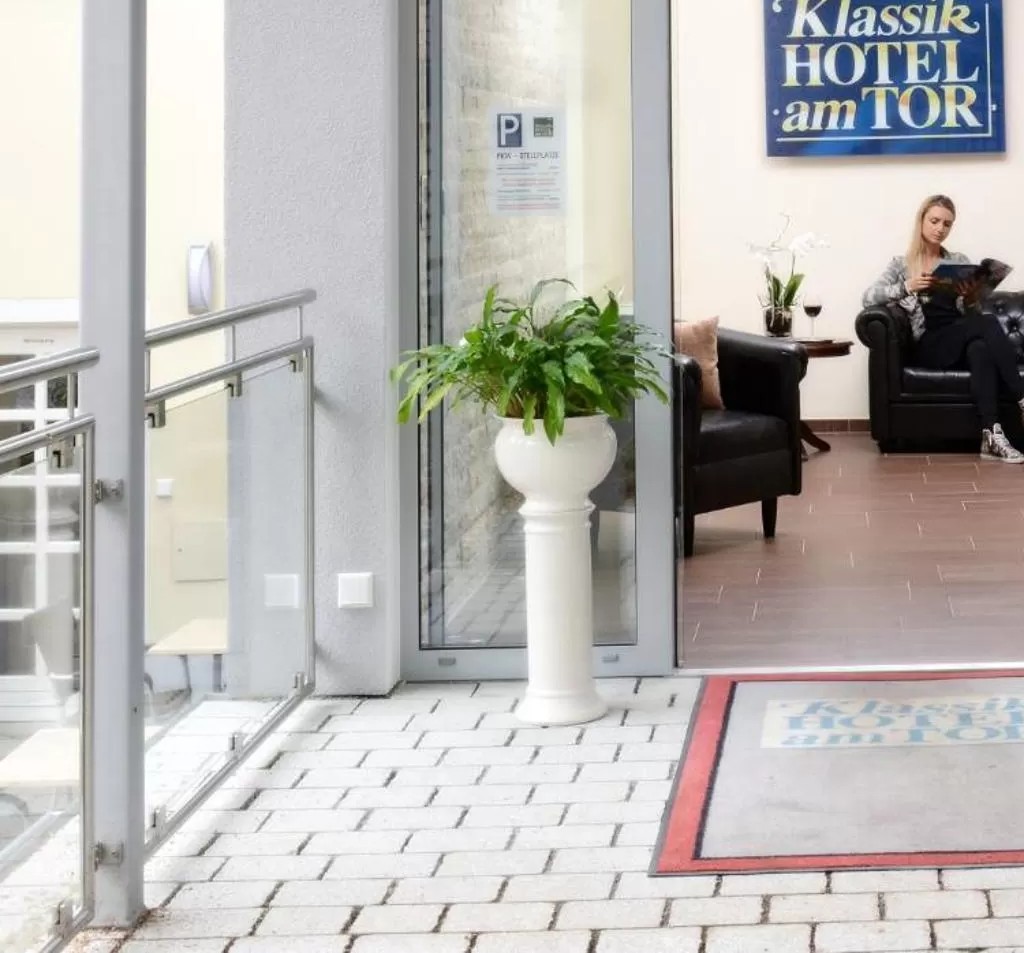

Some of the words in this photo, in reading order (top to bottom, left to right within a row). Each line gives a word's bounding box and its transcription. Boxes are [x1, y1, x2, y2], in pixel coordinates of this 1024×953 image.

[781, 39, 980, 87] HOTEL
[782, 98, 857, 132] am
[861, 84, 983, 129] TOR
[781, 734, 884, 745] am
